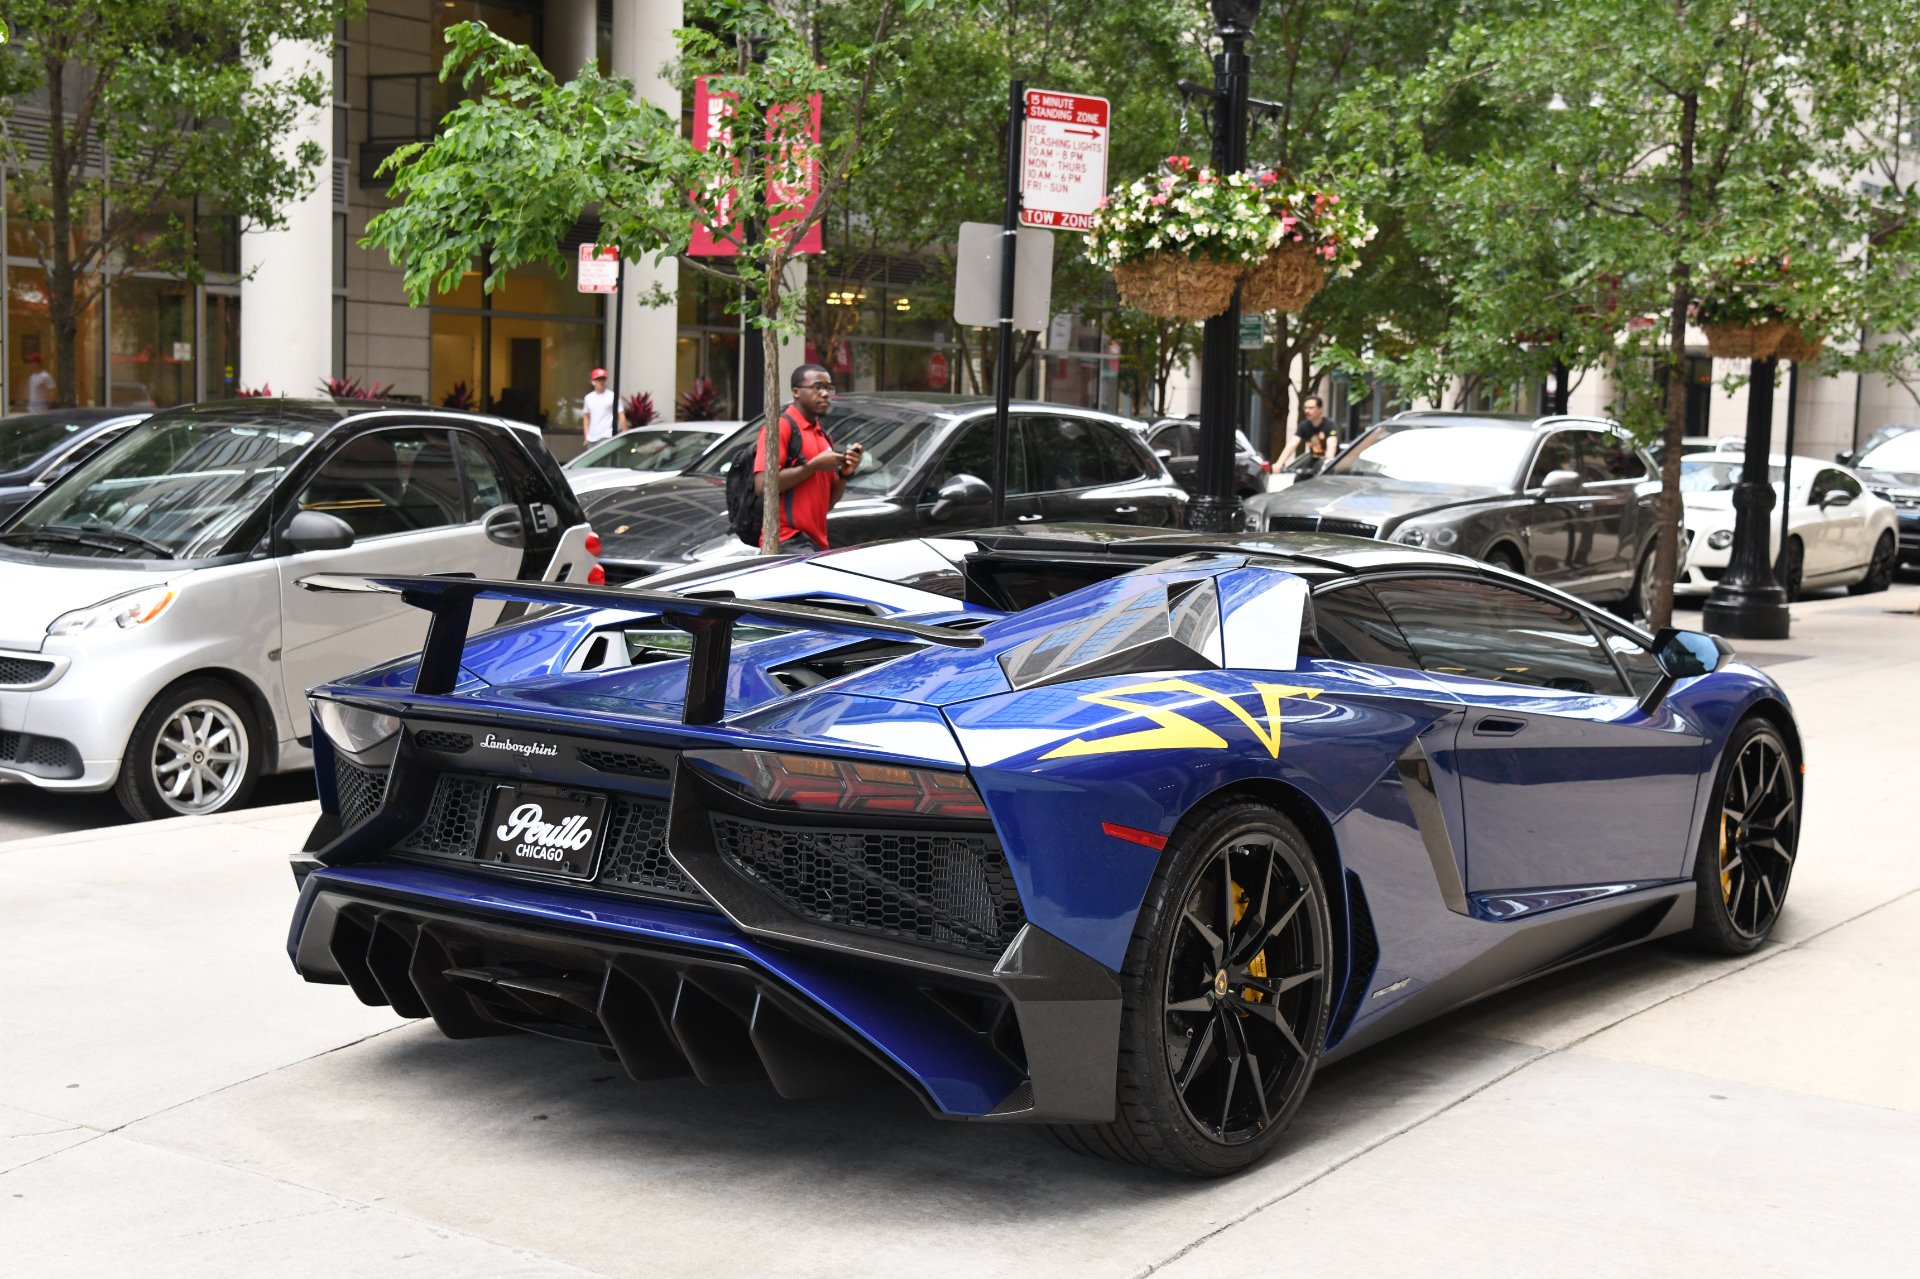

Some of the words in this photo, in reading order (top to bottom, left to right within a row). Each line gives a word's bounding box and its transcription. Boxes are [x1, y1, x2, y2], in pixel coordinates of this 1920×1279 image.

[1030, 94, 1040, 105] 15
[1042, 96, 1075, 110] MINUTE
[1030, 106, 1073, 121] STANDING
[1077, 111, 1100, 124] ZONE
[1029, 124, 1047, 135] USE
[1028, 135, 1072, 149] FLASHING
[1073, 140, 1102, 153] LIGHTS
[1028, 147, 1038, 156] 10
[1040, 148, 1053, 158] AM
[1062, 151, 1068, 159] 8
[1070, 151, 1083, 161] PM
[1028, 158, 1047, 168] MON
[1058, 161, 1087, 173] THURS
[1027, 169, 1036, 179] 10
[1038, 170, 1051, 180] AM
[1061, 173, 1066, 182] 6
[1068, 174, 1081, 184] PM
[1027, 180, 1041, 191] FRI
[1050, 182, 1069, 193] SUN
[1026, 209, 1055, 224] TOW
[1061, 213, 1096, 228] ZONE
[480, 733, 558, 757] Lamborghini
[497, 803, 593, 851] Perillo
[515, 843, 564, 862] CHICAGO
